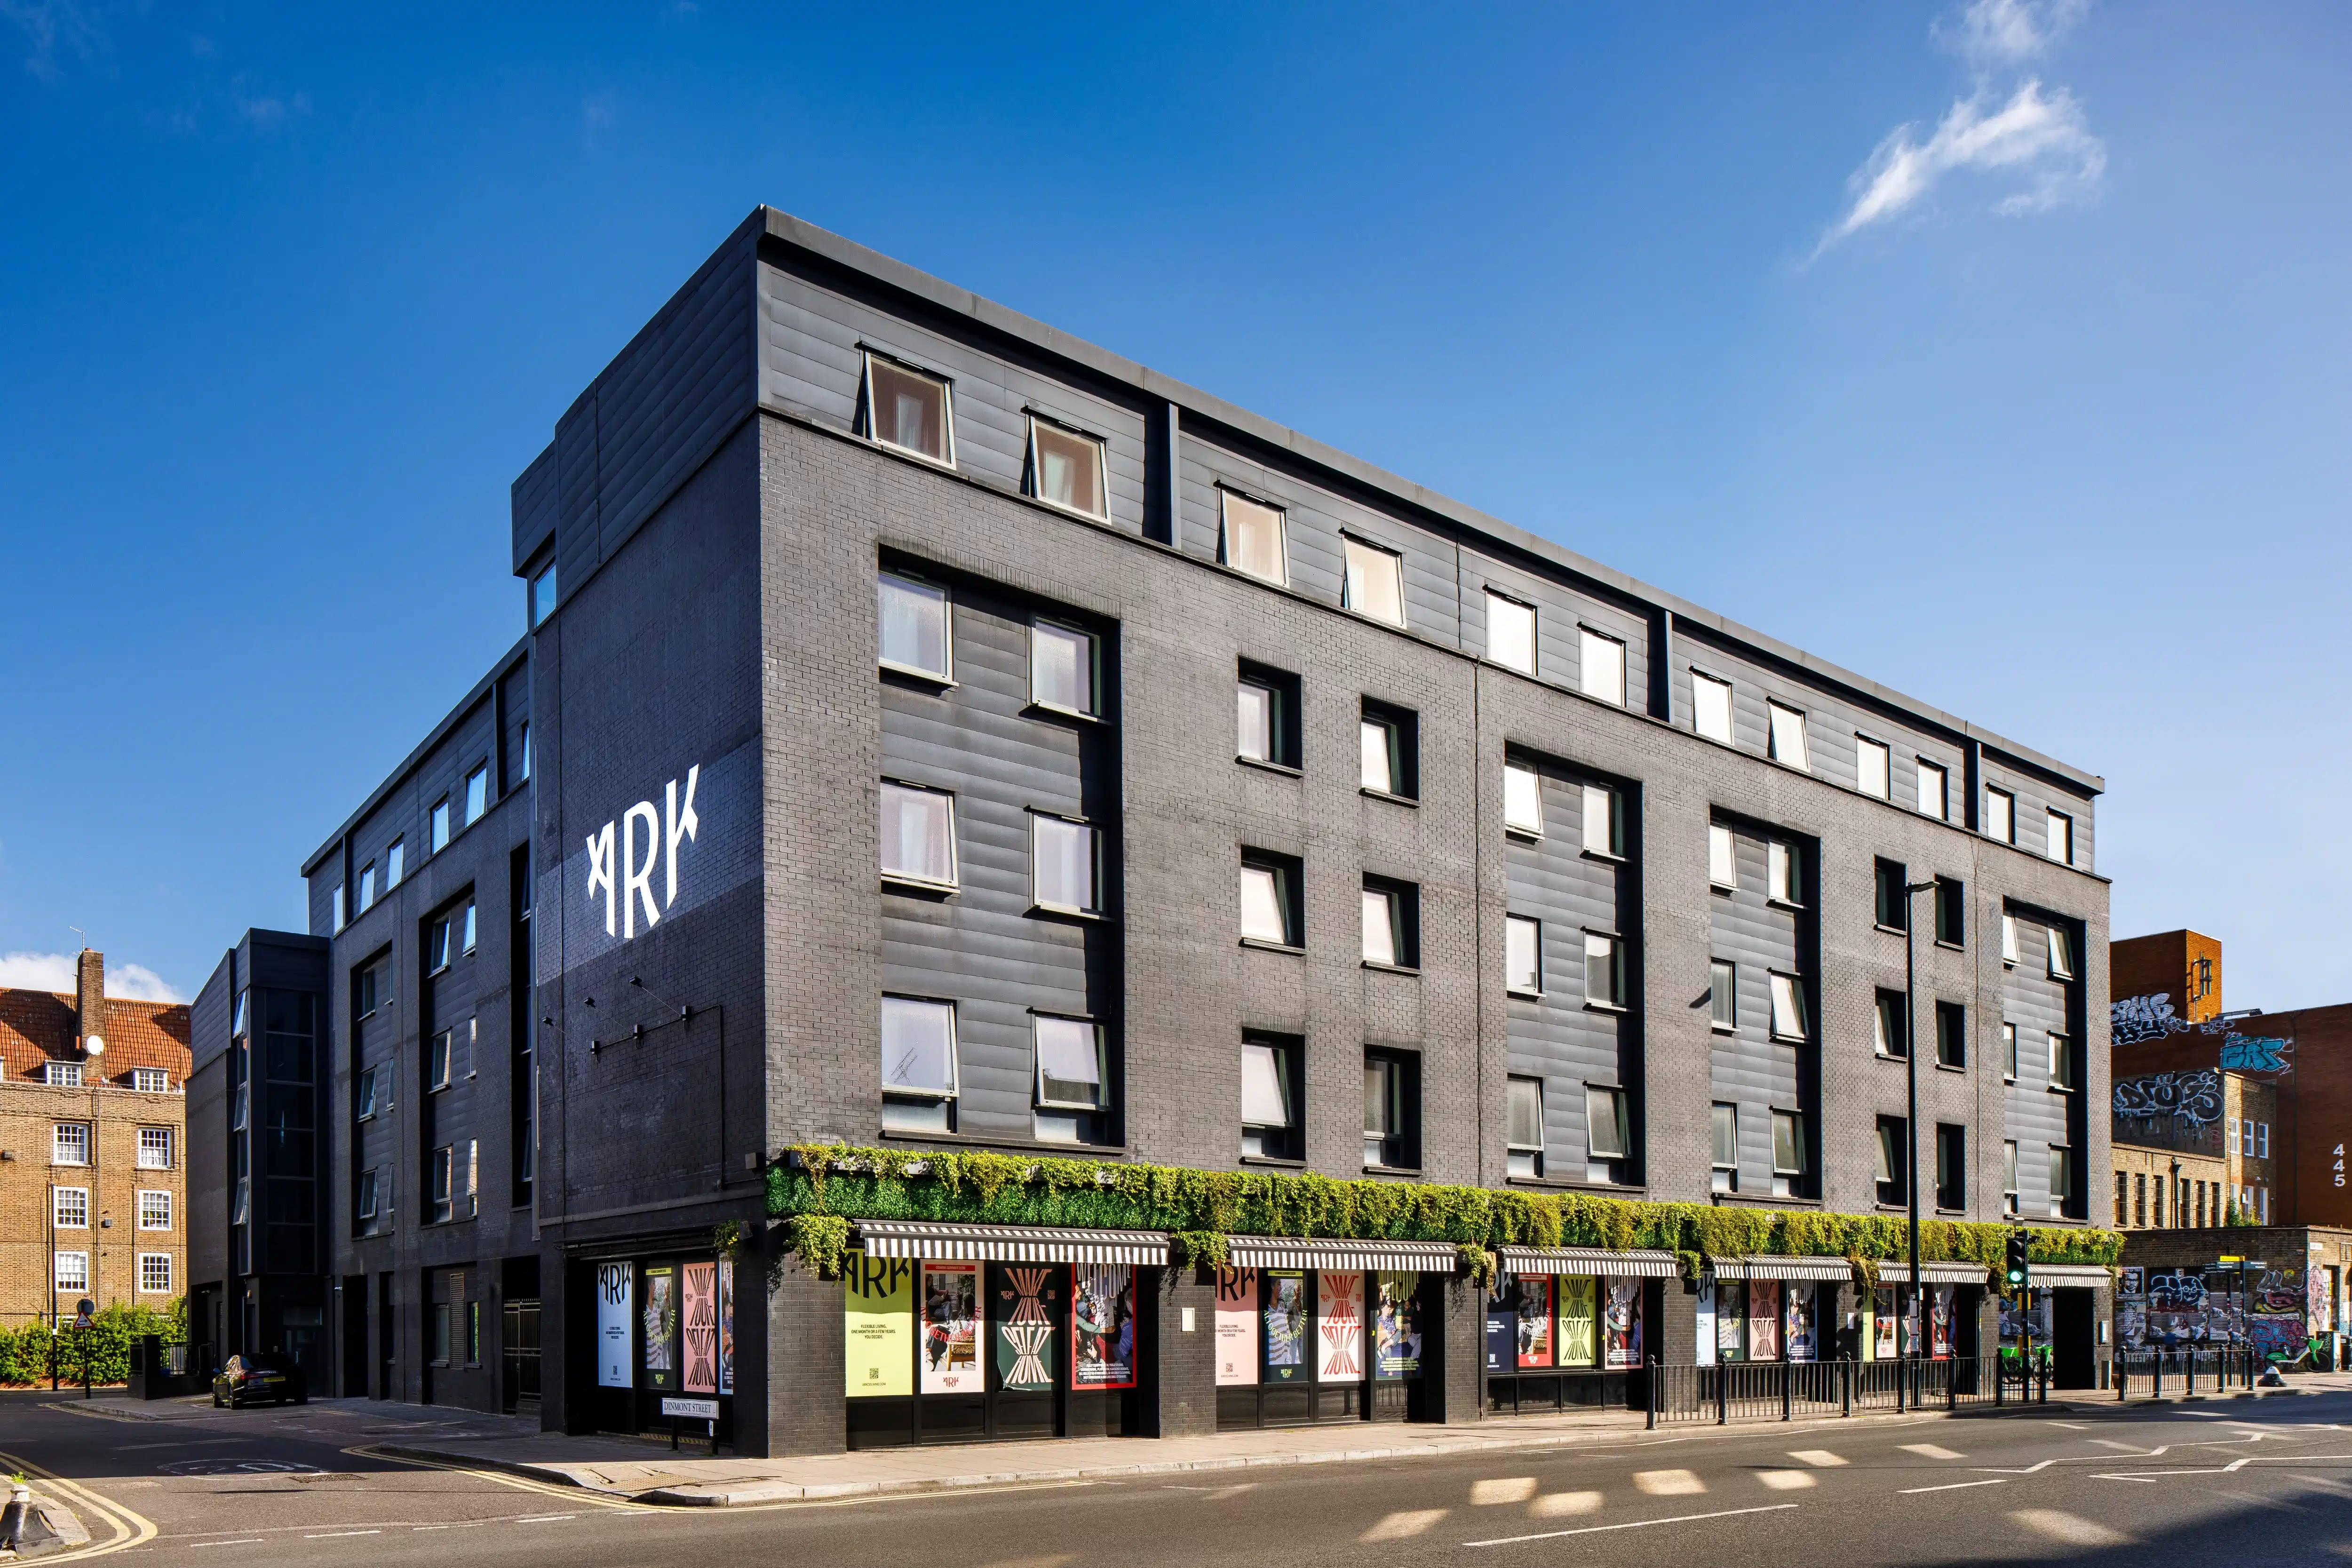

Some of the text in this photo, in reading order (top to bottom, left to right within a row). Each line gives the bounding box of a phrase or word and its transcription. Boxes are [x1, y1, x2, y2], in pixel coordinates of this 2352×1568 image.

[586, 764, 699, 939] ARK
[2333, 1144, 2346, 1186] 445
[599, 1264, 631, 1305] ARK
[688, 1267, 715, 1296] MAKE
[845, 1251, 909, 1298] ARK
[1005, 1268, 1053, 1296] MAKE
[1216, 1262, 1255, 1301] RK
[1324, 1275, 1359, 1299] MAKE
[1487, 1268, 1512, 1303] RK
[1001, 1290, 1014, 1300] ARK
[644, 1309, 675, 1345] ALTOGETHER BETTER
[1264, 1309, 1308, 1342] ALTOGETHER BETTER
[1001, 1326, 1056, 1355] SELF AT
[1005, 1355, 1054, 1384] HOME
[1280, 1369, 1292, 1378] ARK
[1323, 1350, 1360, 1374] HOME
[655, 1374, 664, 1385] ARK
[943, 1377, 959, 1387] ARK
[664, 1402, 691, 1412] DINMONT
[692, 1404, 711, 1413] STREET
